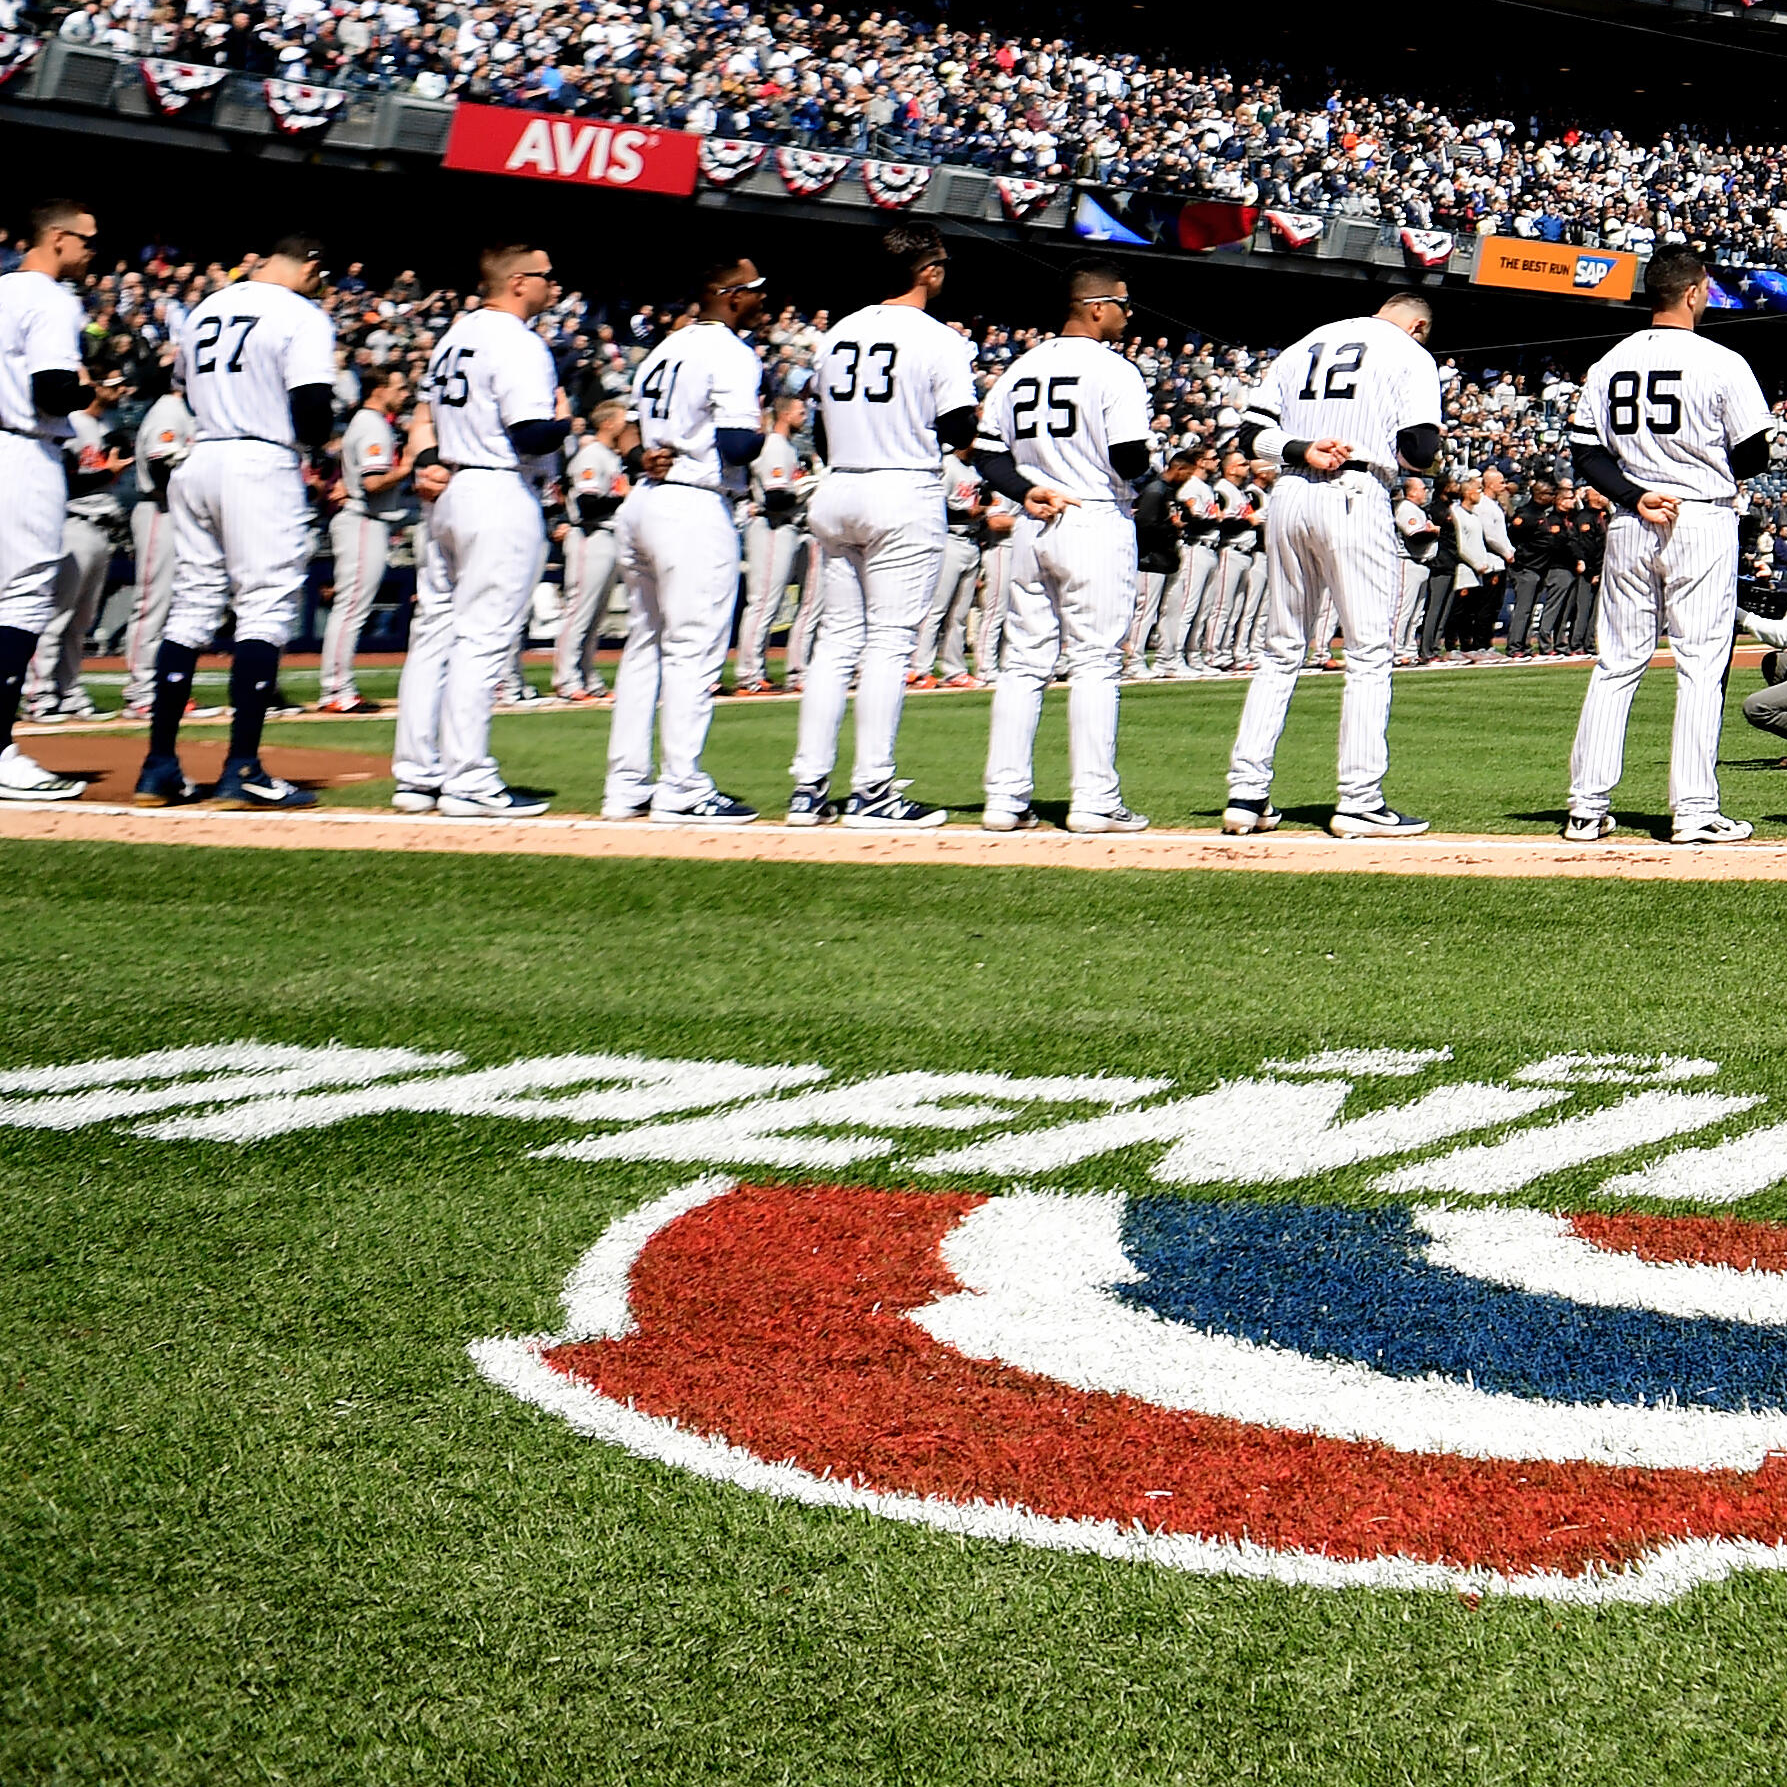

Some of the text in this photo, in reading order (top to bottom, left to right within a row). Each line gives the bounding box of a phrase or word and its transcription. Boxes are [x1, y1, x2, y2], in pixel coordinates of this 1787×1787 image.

[505, 118, 648, 184] AVIS
[1500, 257, 1571, 276] THE BEST RUN
[1574, 260, 1608, 284] SAP
[195, 315, 260, 374] 27
[829, 340, 898, 404] 33
[1298, 341, 1367, 401] 12
[431, 345, 475, 409] 45
[641, 358, 672, 420] 41
[1010, 375, 1080, 441] 25
[1606, 369, 1683, 437] 85
